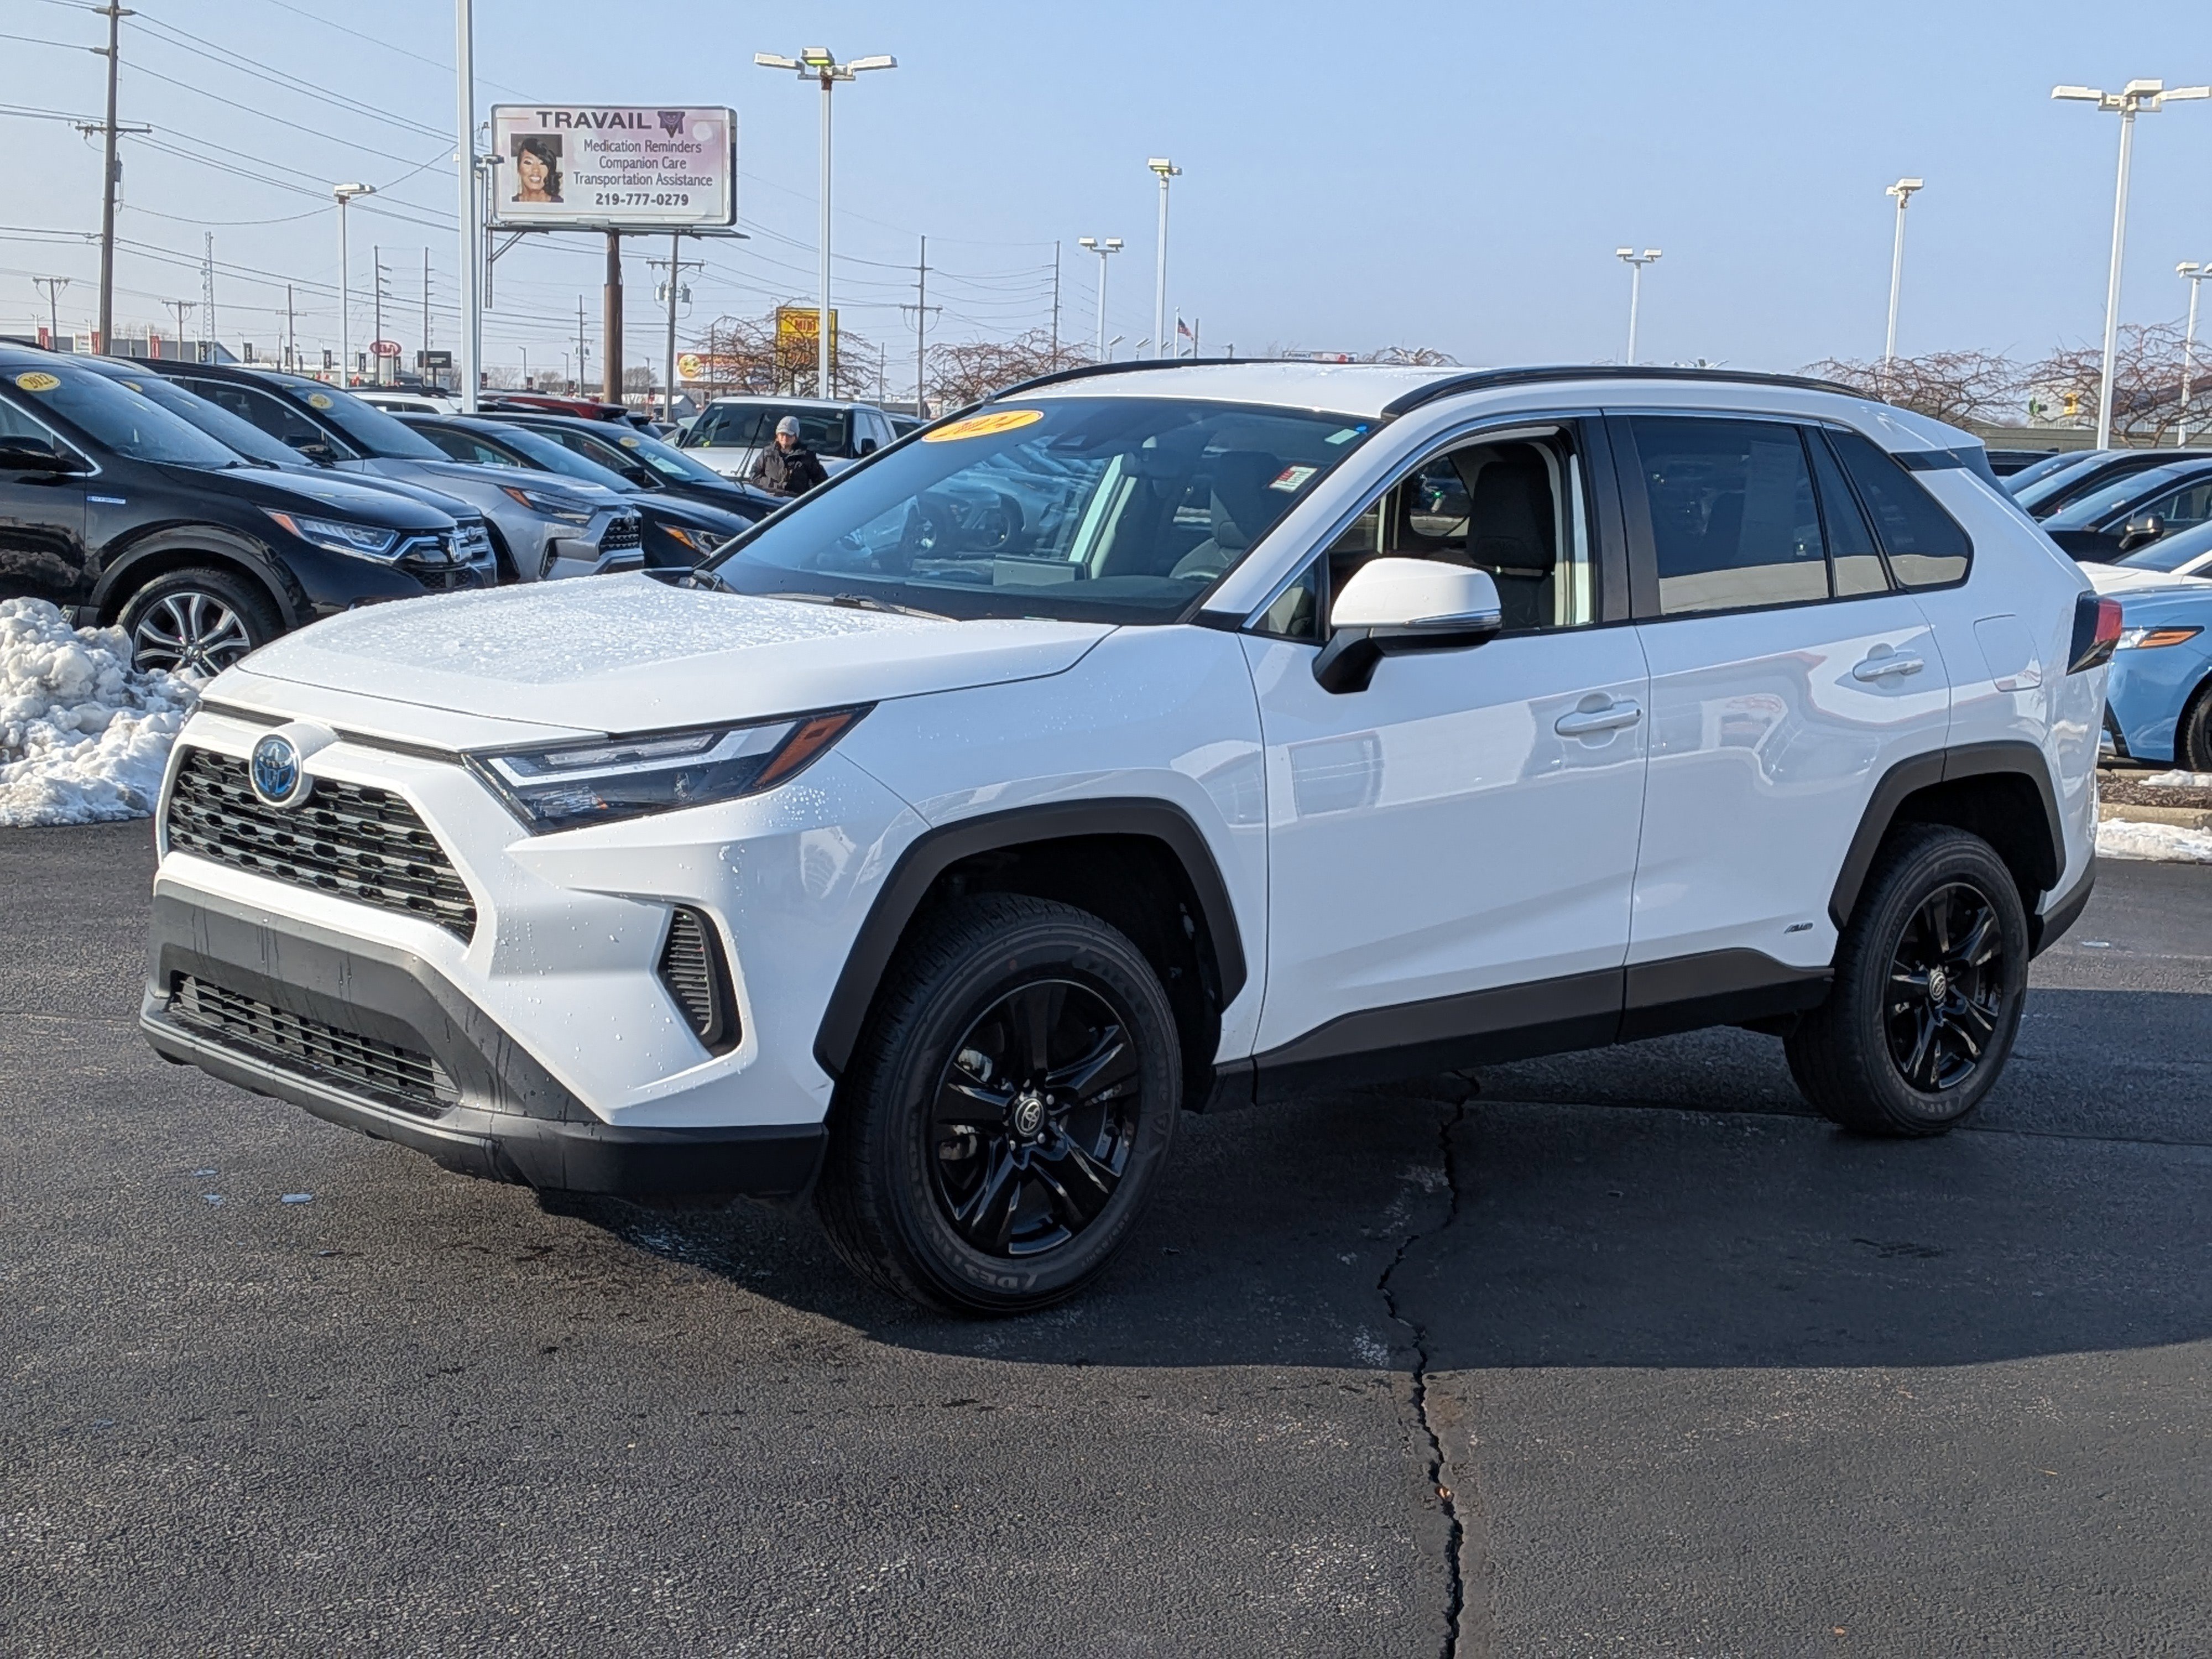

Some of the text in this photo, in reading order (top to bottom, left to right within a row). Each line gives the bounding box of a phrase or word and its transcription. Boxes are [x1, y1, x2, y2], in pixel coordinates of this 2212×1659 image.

[536, 111, 652, 129] TRAVAIL
[584, 139, 702, 153] Medication Reminders
[599, 155, 687, 171] Companion Care
[573, 171, 713, 187] Transportation Assistance
[596, 192, 689, 206] 219-777-0279
